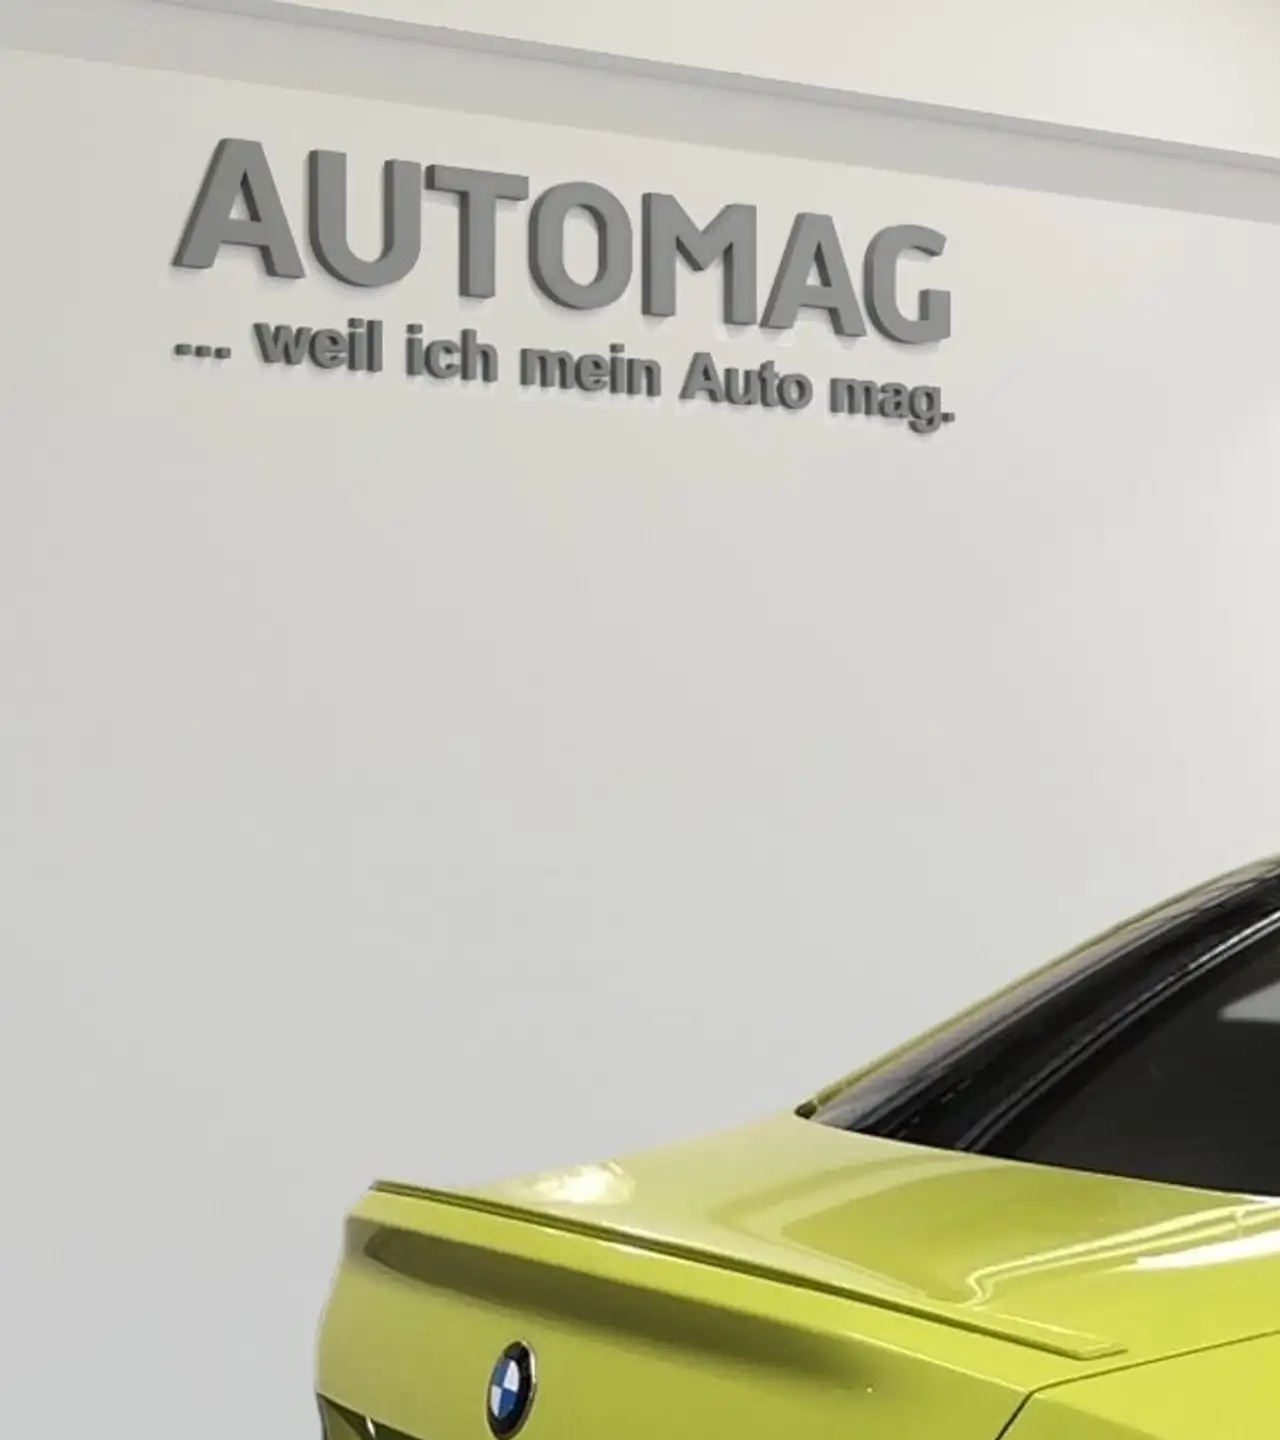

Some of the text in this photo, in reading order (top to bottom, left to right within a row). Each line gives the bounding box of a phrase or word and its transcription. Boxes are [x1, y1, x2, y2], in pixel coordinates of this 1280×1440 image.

[172, 138, 951, 344] AUTOMAG
[254, 317, 383, 374] weil
[404, 323, 498, 383] ich
[520, 343, 661, 398] mein
[679, 351, 814, 411] Auto
[830, 375, 955, 434] mag.
